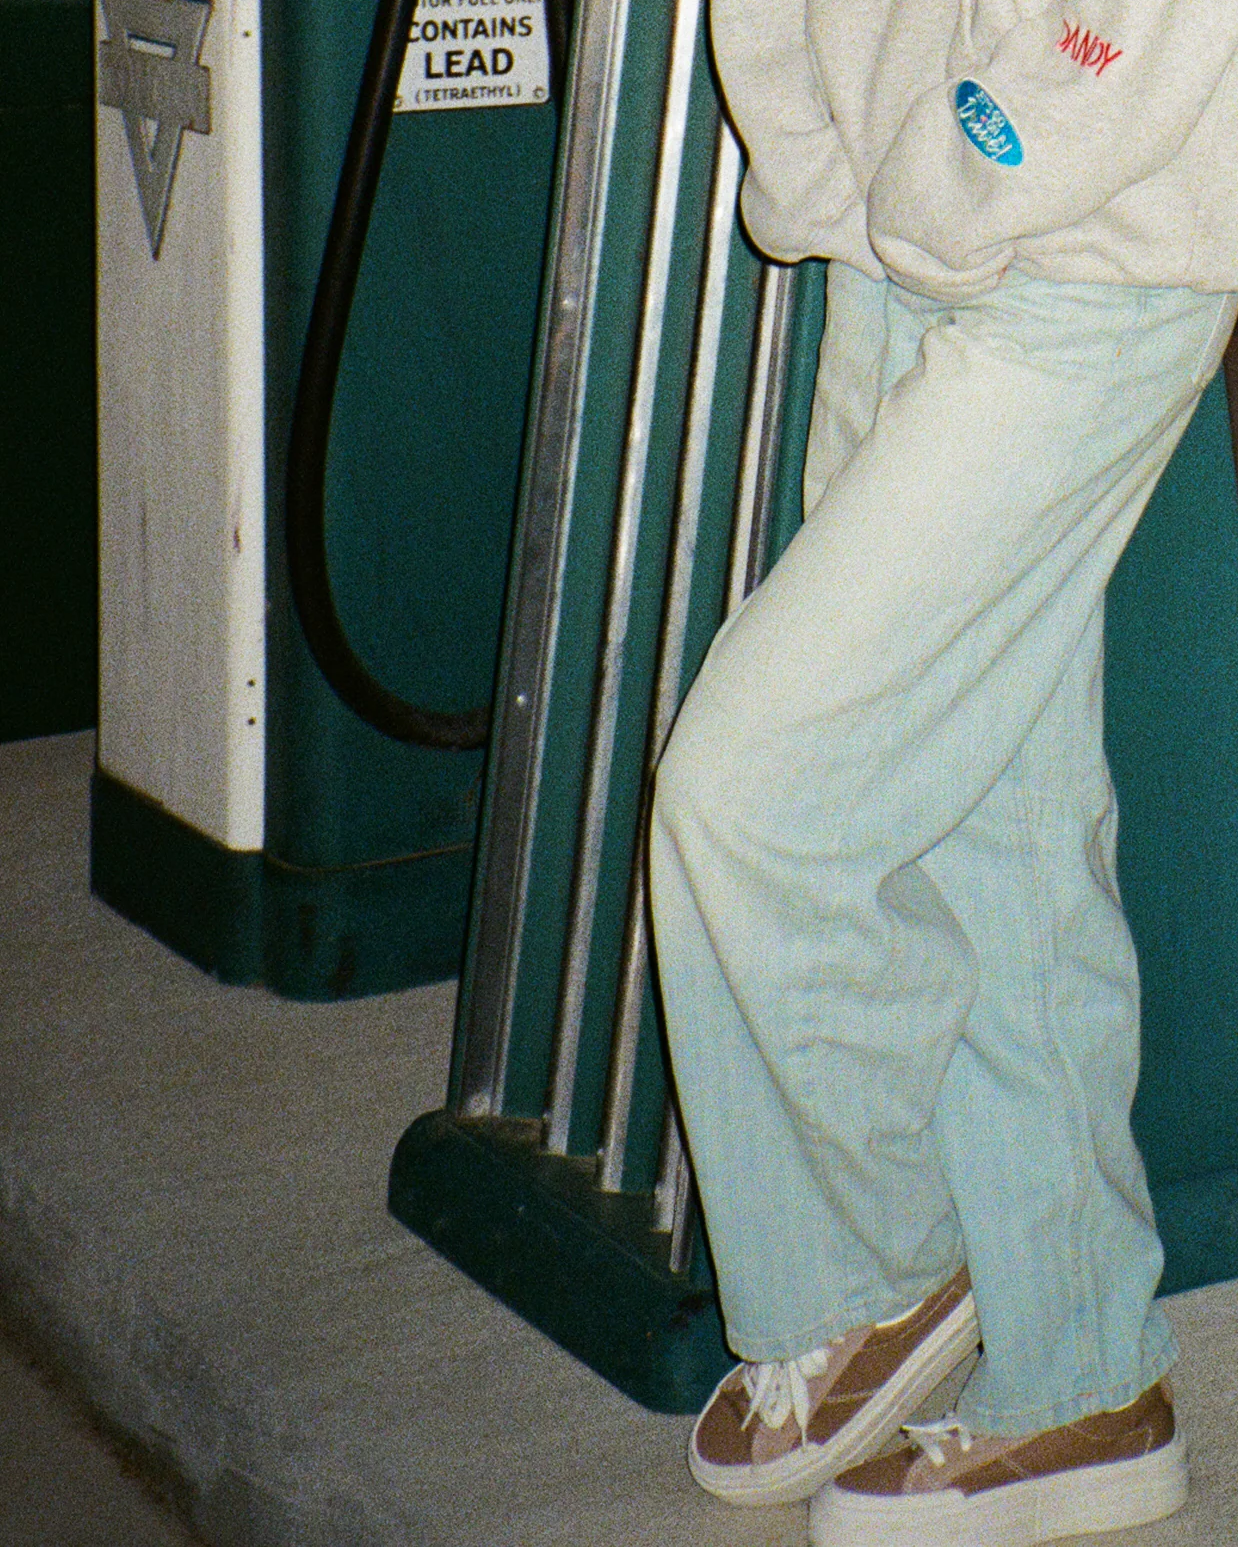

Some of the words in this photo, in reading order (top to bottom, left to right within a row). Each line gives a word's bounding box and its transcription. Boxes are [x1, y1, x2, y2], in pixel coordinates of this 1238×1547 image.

[408, 15, 533, 43] CONTAINS
[425, 47, 515, 79] LEAD
[415, 85, 521, 104] (TETRAETHYL)
